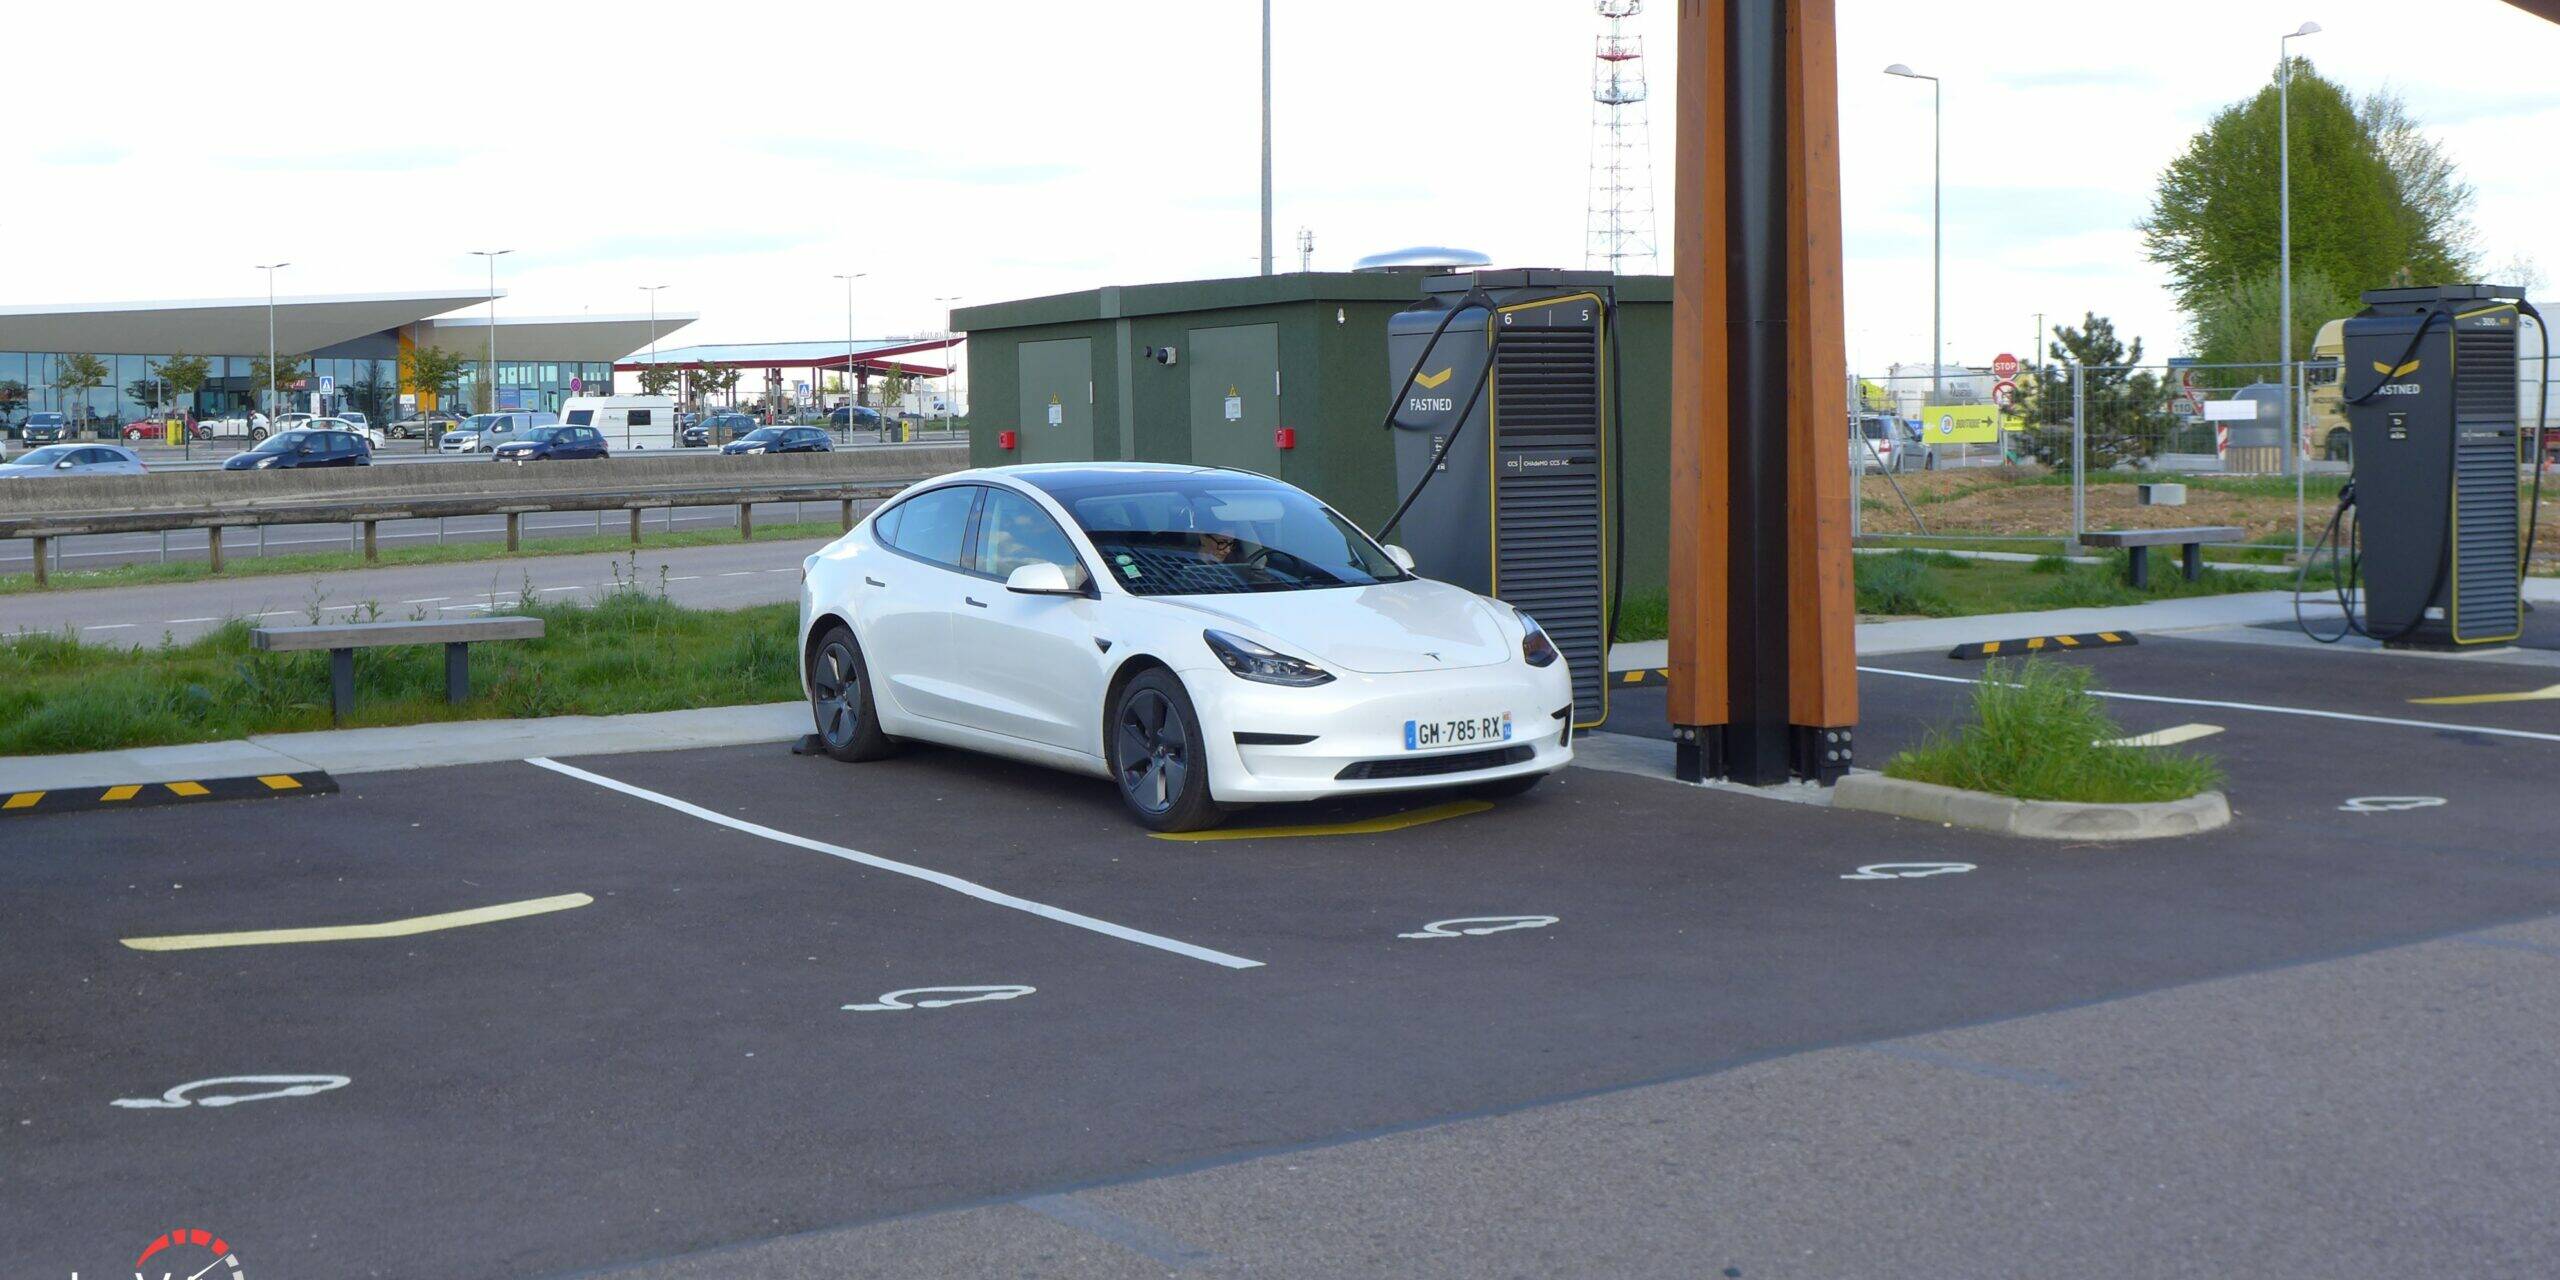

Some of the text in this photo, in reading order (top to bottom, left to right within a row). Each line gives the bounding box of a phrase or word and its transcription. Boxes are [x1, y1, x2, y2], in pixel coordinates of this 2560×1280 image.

[1504, 309, 1589, 325] 6 5
[1994, 362, 2017, 371] STOP
[2373, 384, 2421, 396] ASTNED
[1410, 398, 1452, 411] FASTNED
